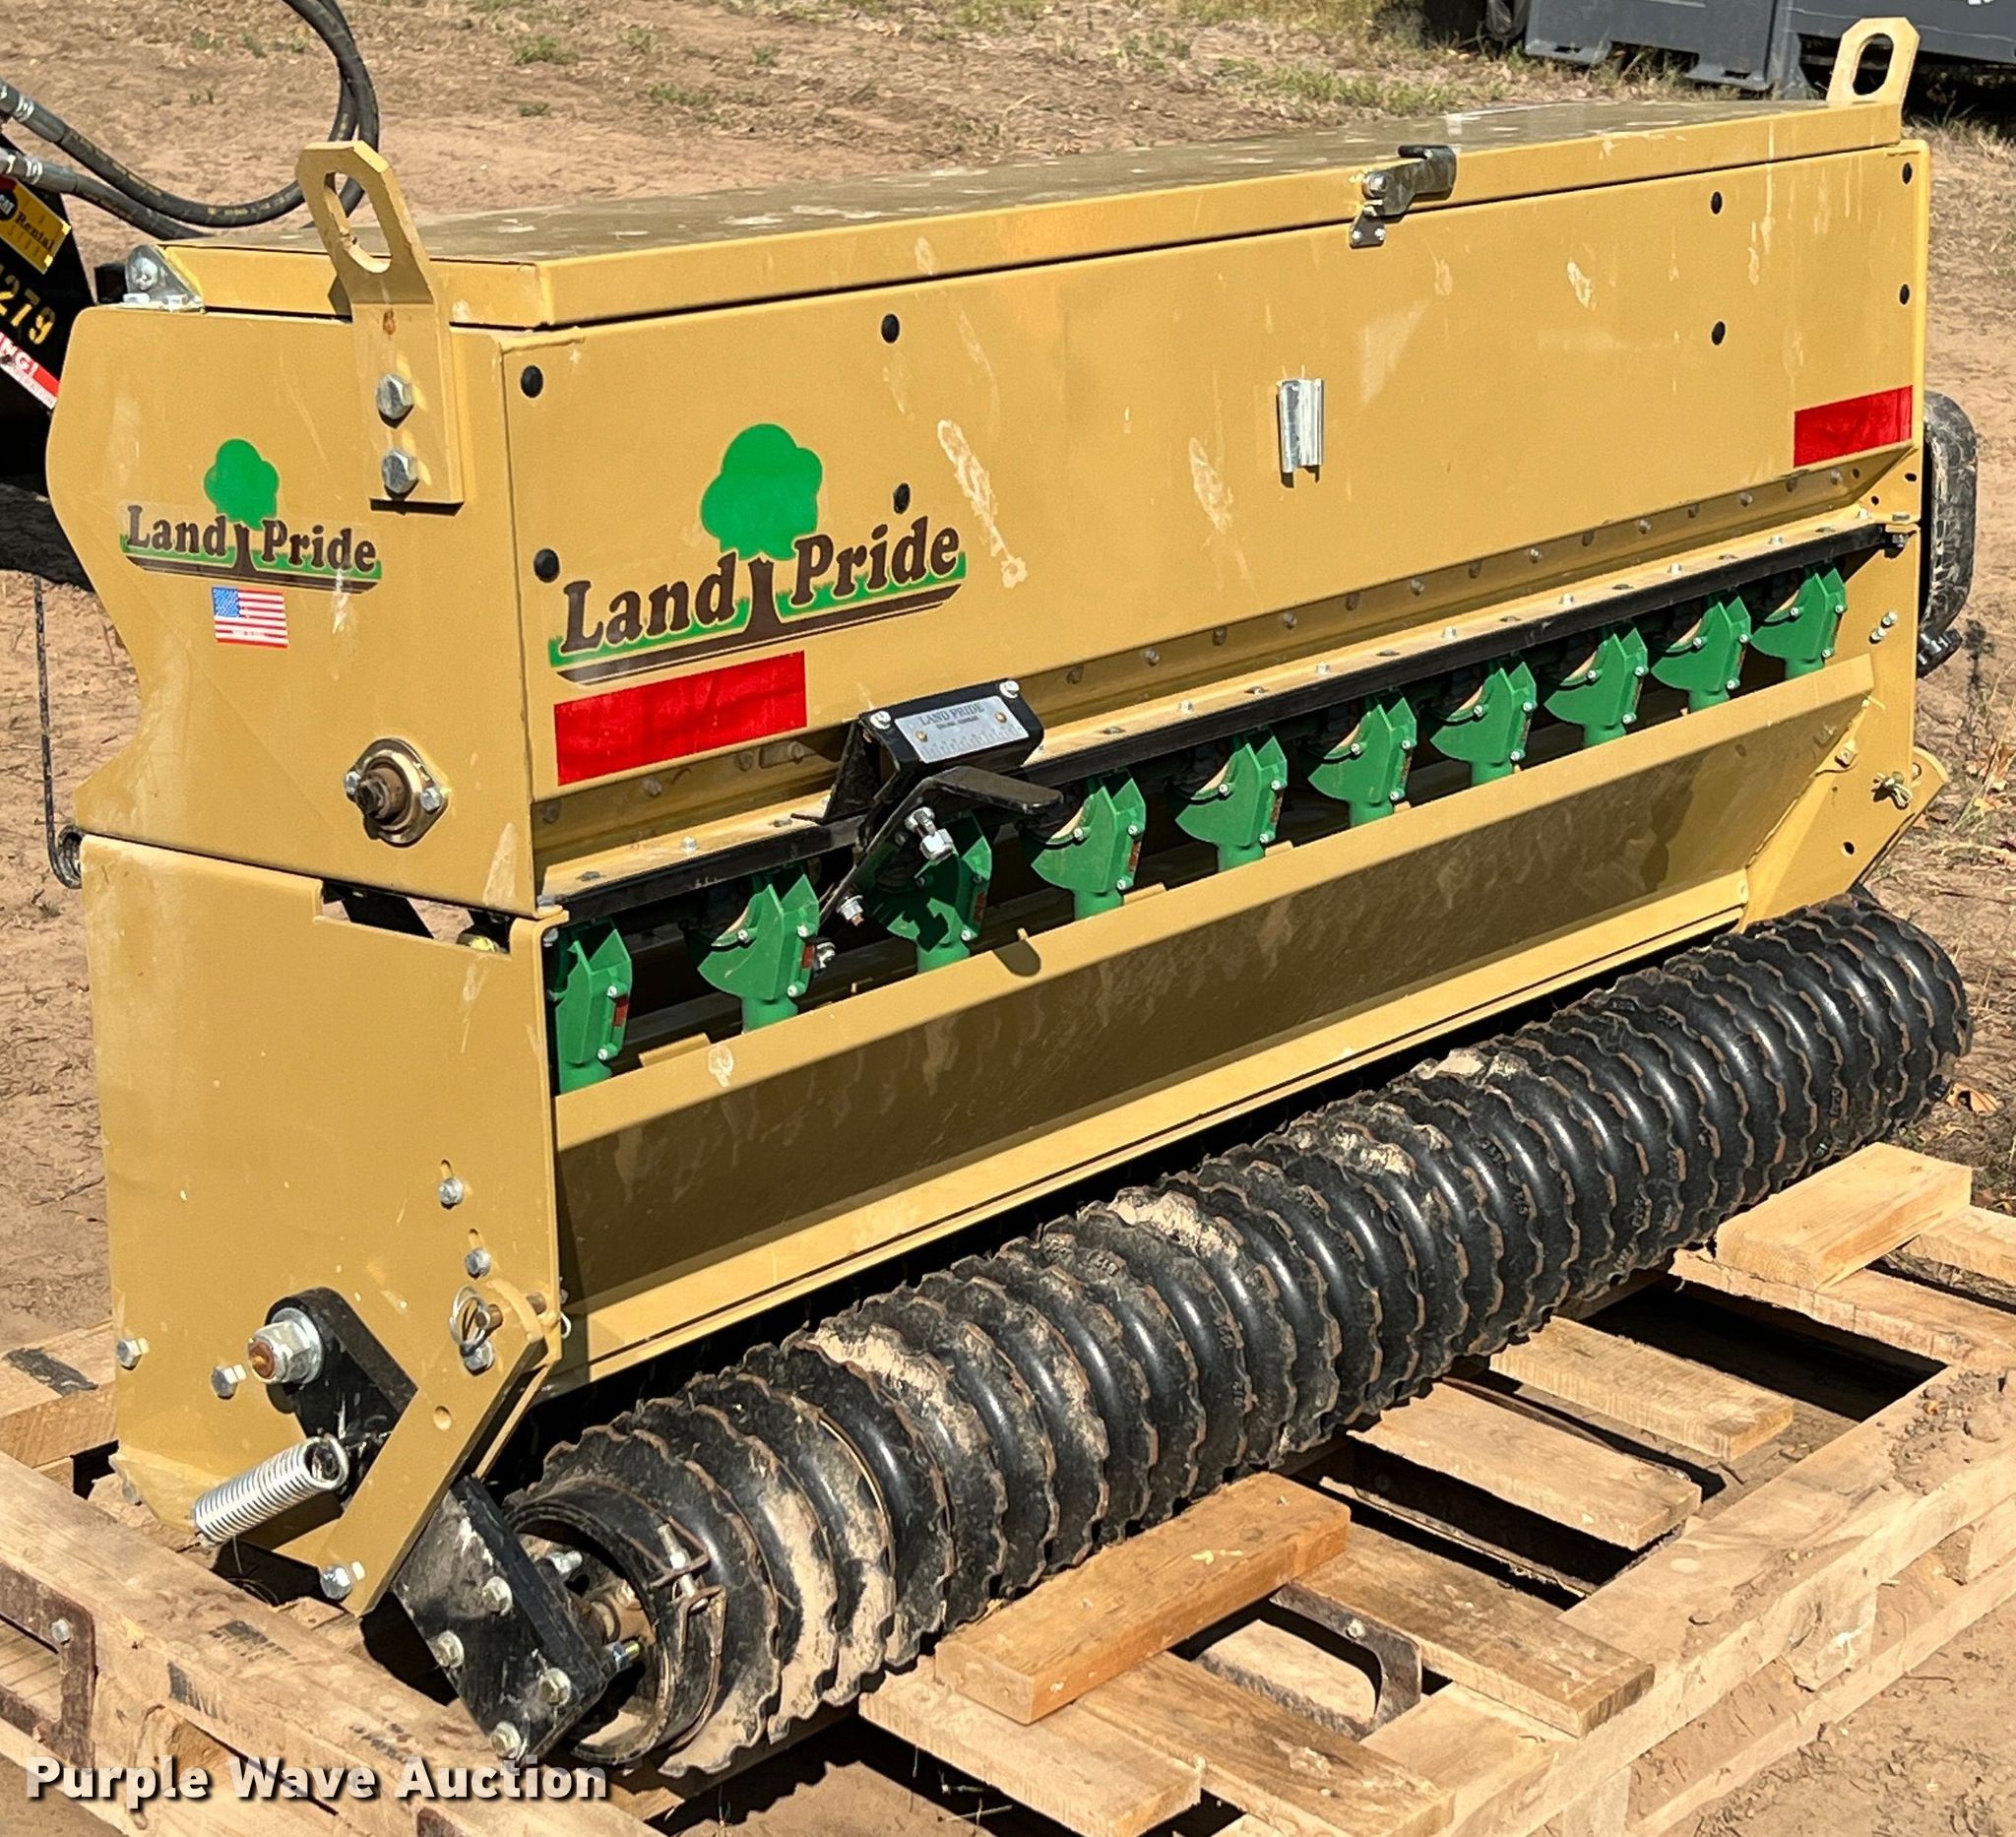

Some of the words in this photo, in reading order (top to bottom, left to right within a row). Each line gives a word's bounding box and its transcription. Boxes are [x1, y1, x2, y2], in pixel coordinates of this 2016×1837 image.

[15, 210, 55, 253] Rental
[127, 505, 226, 556] Land
[262, 519, 376, 572] Pride
[560, 552, 737, 654] Land
[790, 516, 959, 605] Pride
[919, 710, 951, 726] LAND
[951, 702, 985, 719] PRIDE
